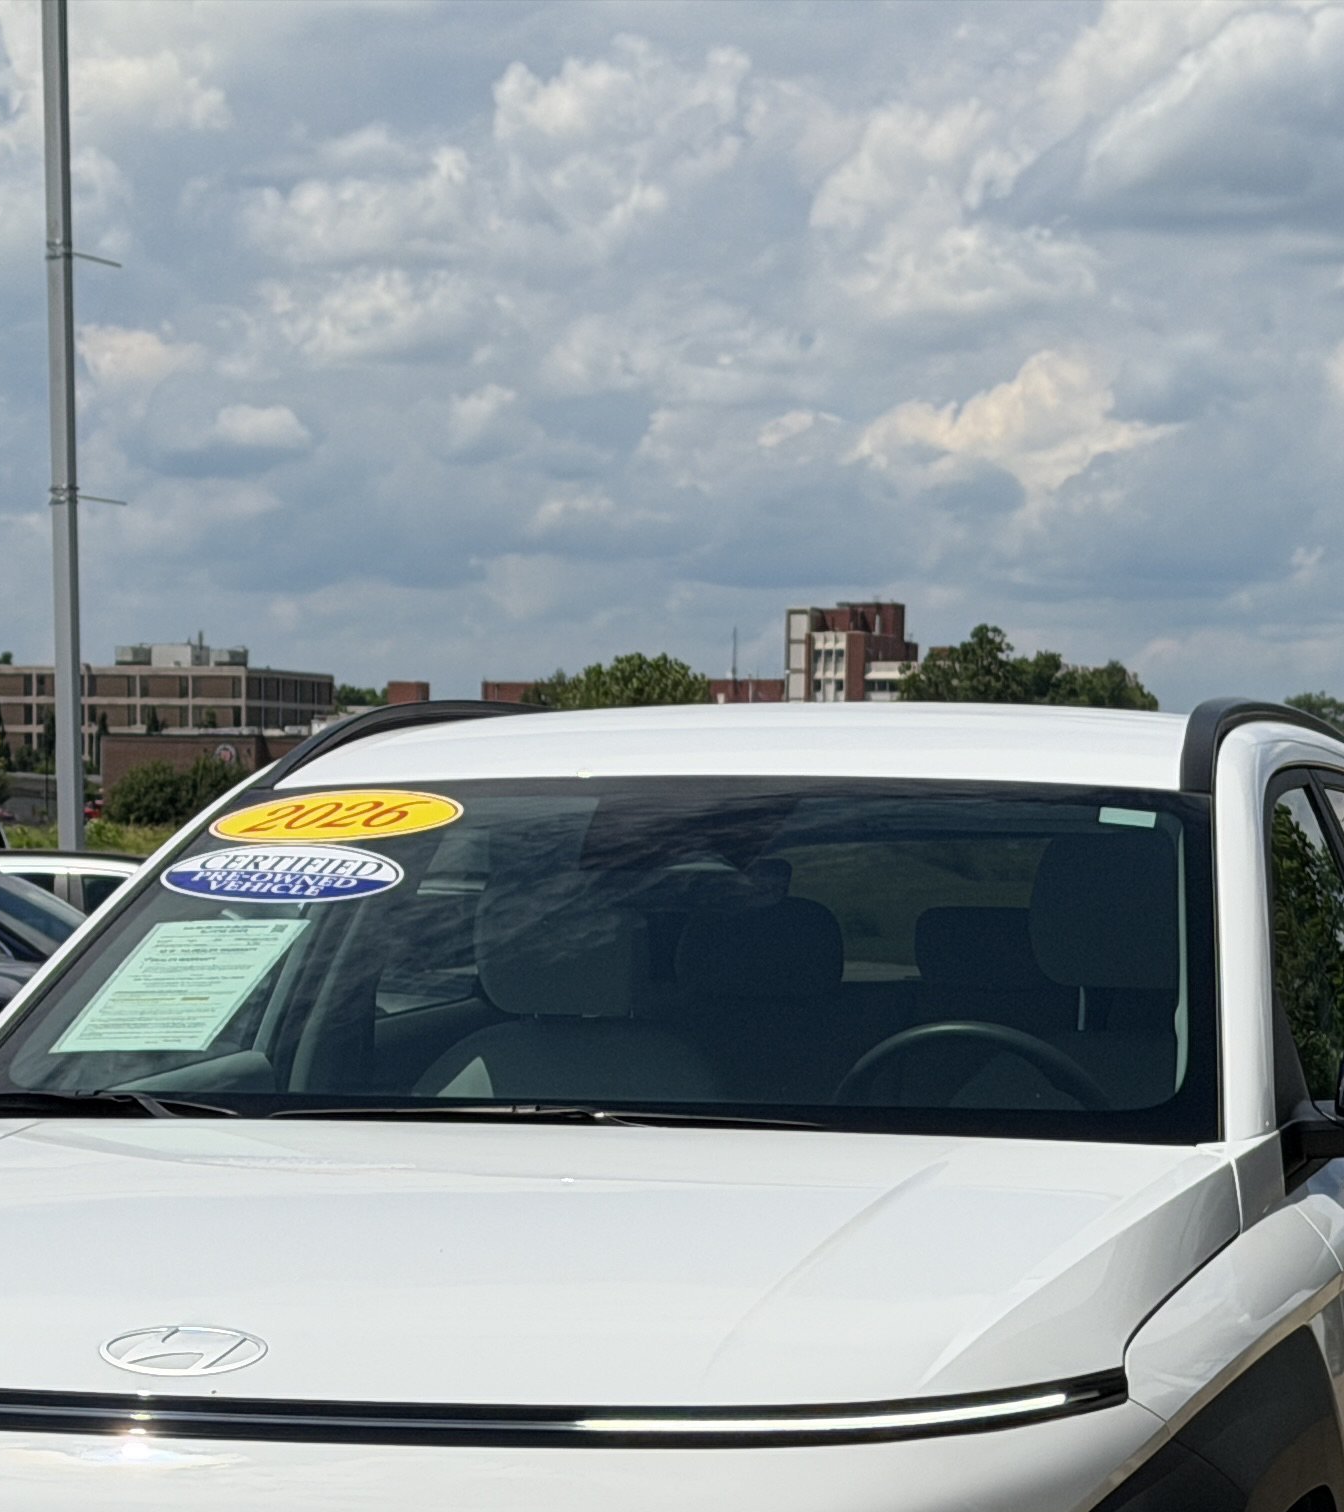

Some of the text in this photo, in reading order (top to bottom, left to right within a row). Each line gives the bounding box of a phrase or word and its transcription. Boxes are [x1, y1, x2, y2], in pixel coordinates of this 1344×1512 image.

[238, 800, 432, 834] 2026
[199, 854, 384, 878] CERTIFIED
[191, 870, 358, 889] PRE-OWNED
[208, 878, 325, 897] VEHICLE
